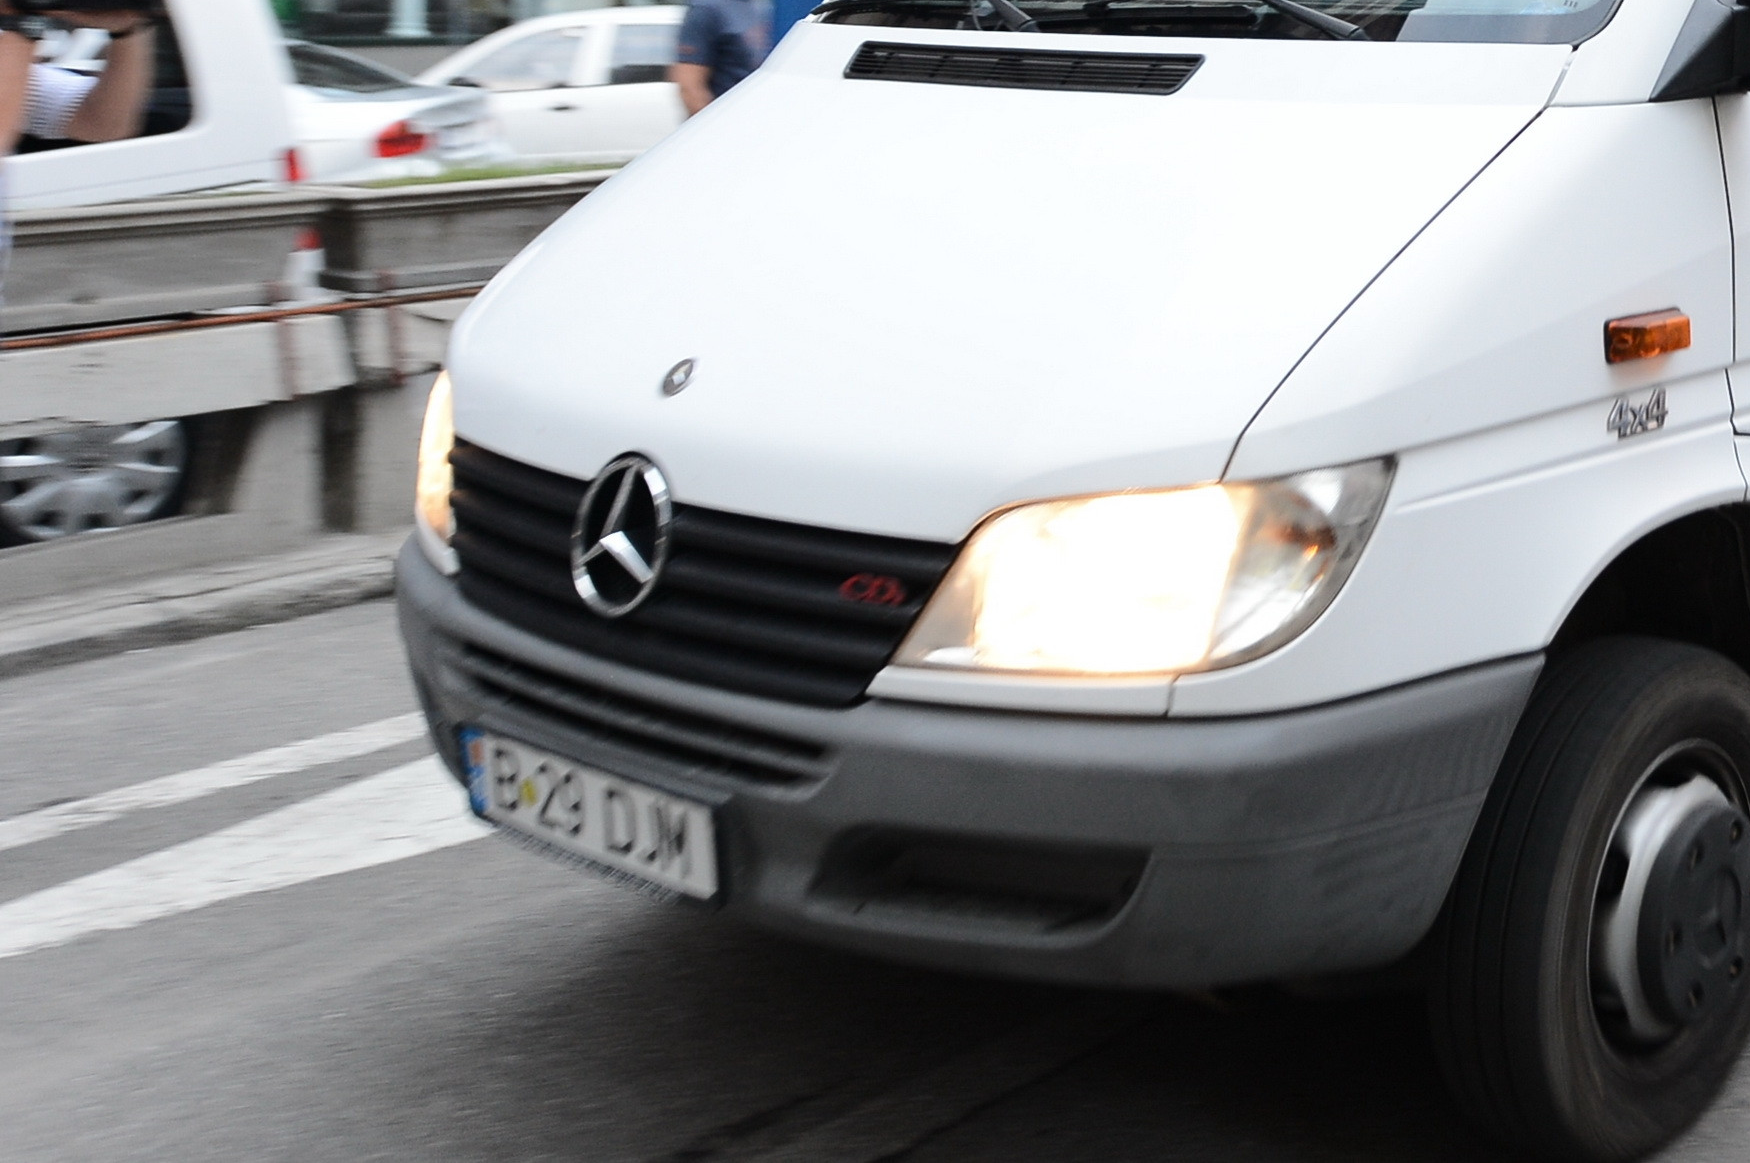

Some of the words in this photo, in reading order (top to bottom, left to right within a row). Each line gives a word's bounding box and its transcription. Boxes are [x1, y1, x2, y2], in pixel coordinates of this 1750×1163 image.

[1606, 387, 1668, 439] 4x4
[493, 746, 520, 812] B
[536, 762, 585, 836] 29
